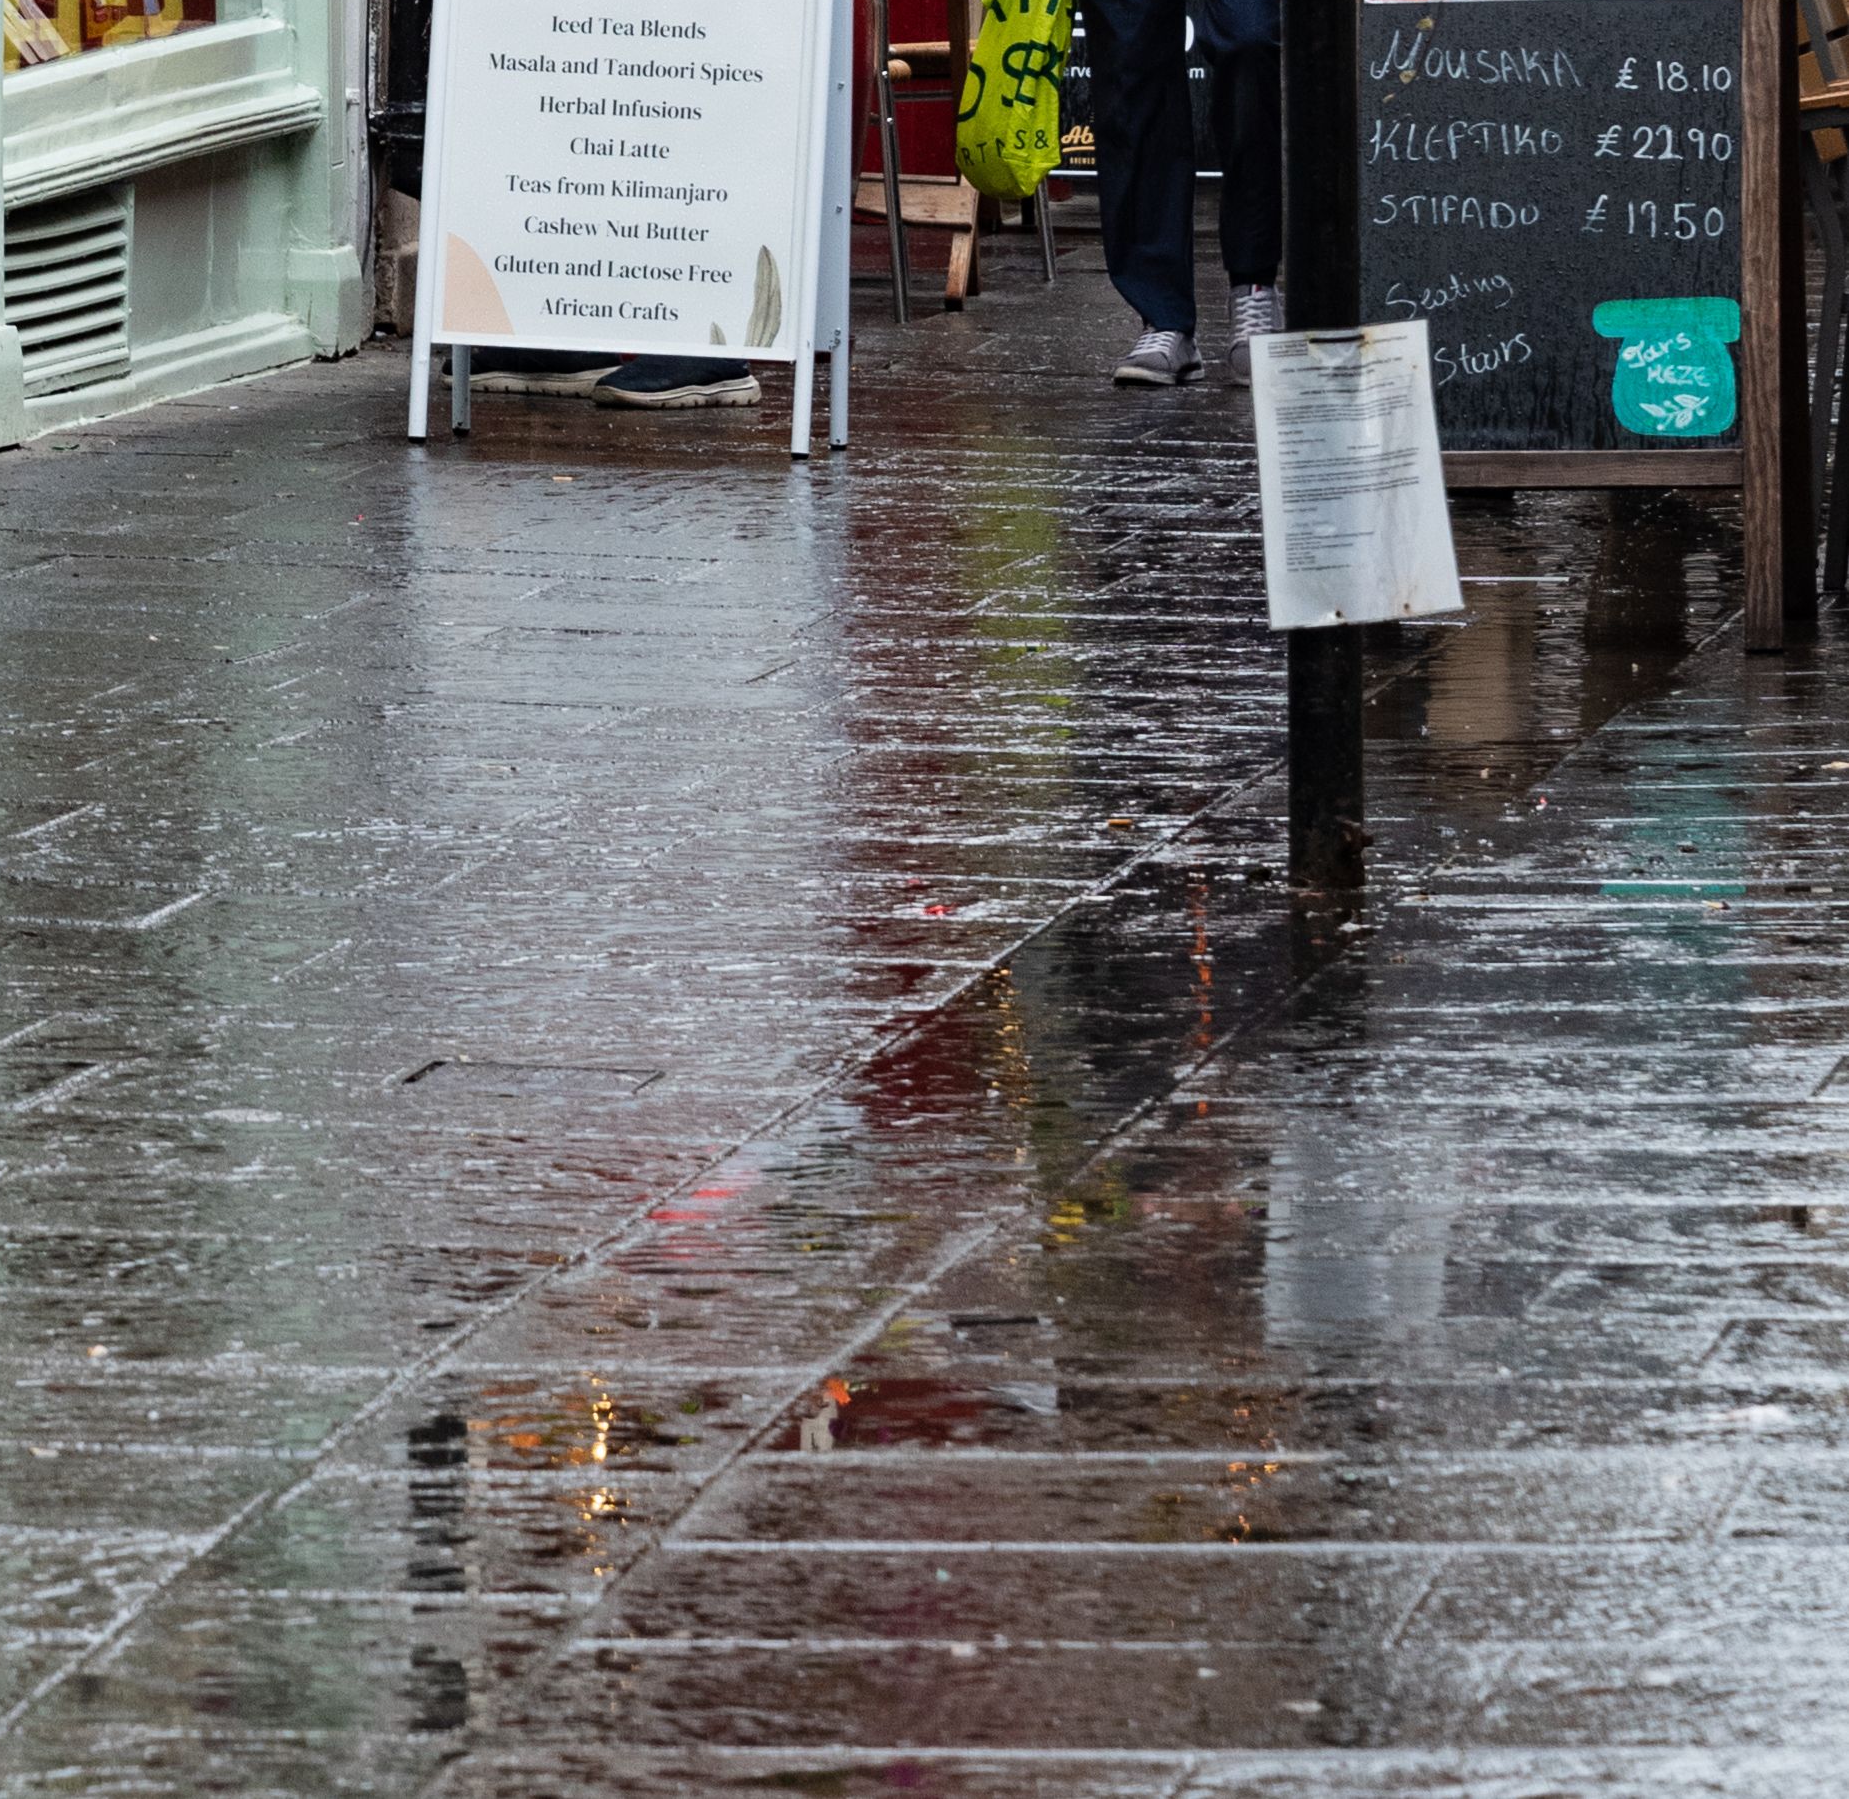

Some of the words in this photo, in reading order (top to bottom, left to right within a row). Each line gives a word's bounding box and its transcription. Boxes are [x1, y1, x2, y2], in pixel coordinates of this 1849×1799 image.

[551, 15, 593, 37] Iced
[598, 17, 635, 38] Tea
[640, 19, 707, 41] Blends
[488, 52, 556, 74] Masala
[561, 56, 598, 76] and
[604, 58, 695, 80] Tandoori
[699, 62, 764, 87] Spices
[1369, 29, 1583, 88] MOUSAKA
[538, 94, 607, 117] Herbal
[611, 98, 703, 121] Infusions
[570, 136, 615, 158] Chai
[619, 139, 671, 161] Latte
[1367, 118, 1564, 165] KLEFTIKO
[505, 174, 551, 195] Teas
[557, 176, 605, 198] from
[610, 178, 729, 206] Kilimanjaro
[1372, 193, 1540, 231] STIFADO
[524, 215, 600, 237] Cashew
[605, 219, 640, 239] Nut
[646, 221, 710, 243] Butter
[493, 254, 559, 276] Gluten
[565, 258, 602, 278] and
[607, 260, 684, 283] Lactose
[688, 263, 733, 284] Free
[539, 296, 613, 319] African
[618, 300, 679, 322] Crafts
